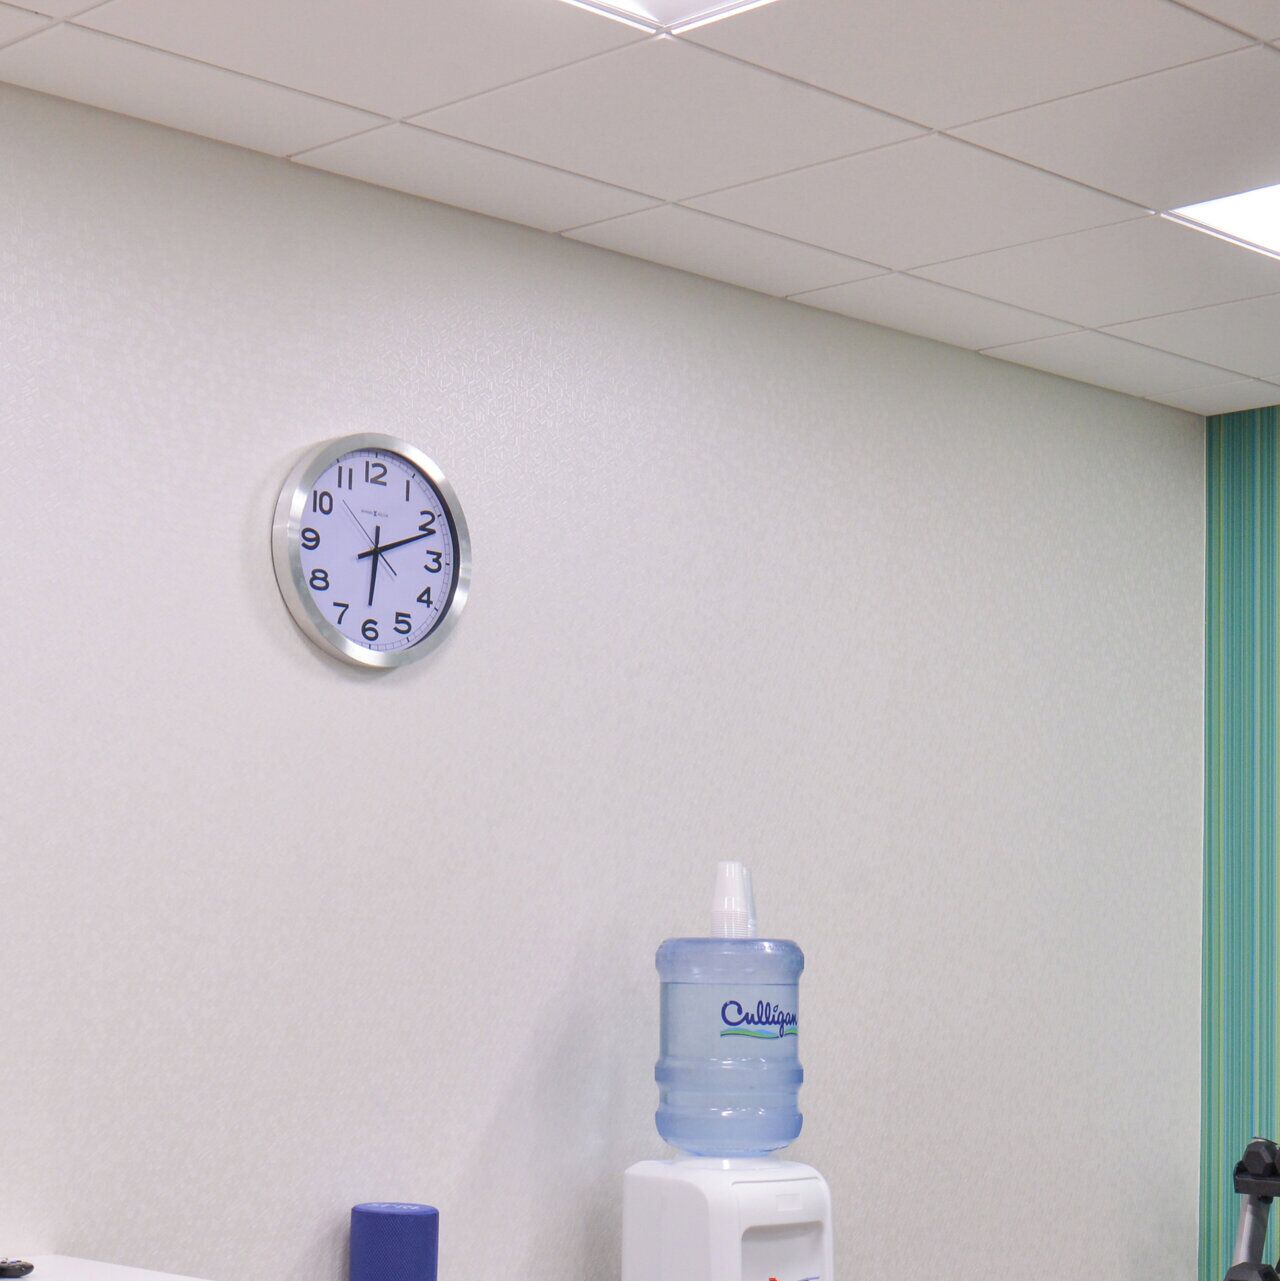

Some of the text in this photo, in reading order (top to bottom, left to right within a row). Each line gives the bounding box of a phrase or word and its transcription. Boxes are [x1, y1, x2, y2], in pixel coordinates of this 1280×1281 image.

[337, 465, 353, 490] 11
[365, 461, 388, 486] 12
[312, 490, 334, 515] 10
[405, 480, 410, 502] 1
[418, 510, 436, 535] 2
[301, 527, 320, 551] 9
[423, 550, 442, 574] 3
[309, 568, 330, 591] 8
[416, 586, 433, 608] 4
[333, 601, 350, 625] 7
[393, 612, 412, 634] 5
[361, 618, 379, 642] 6
[721, 1000, 798, 1038] Culligan
